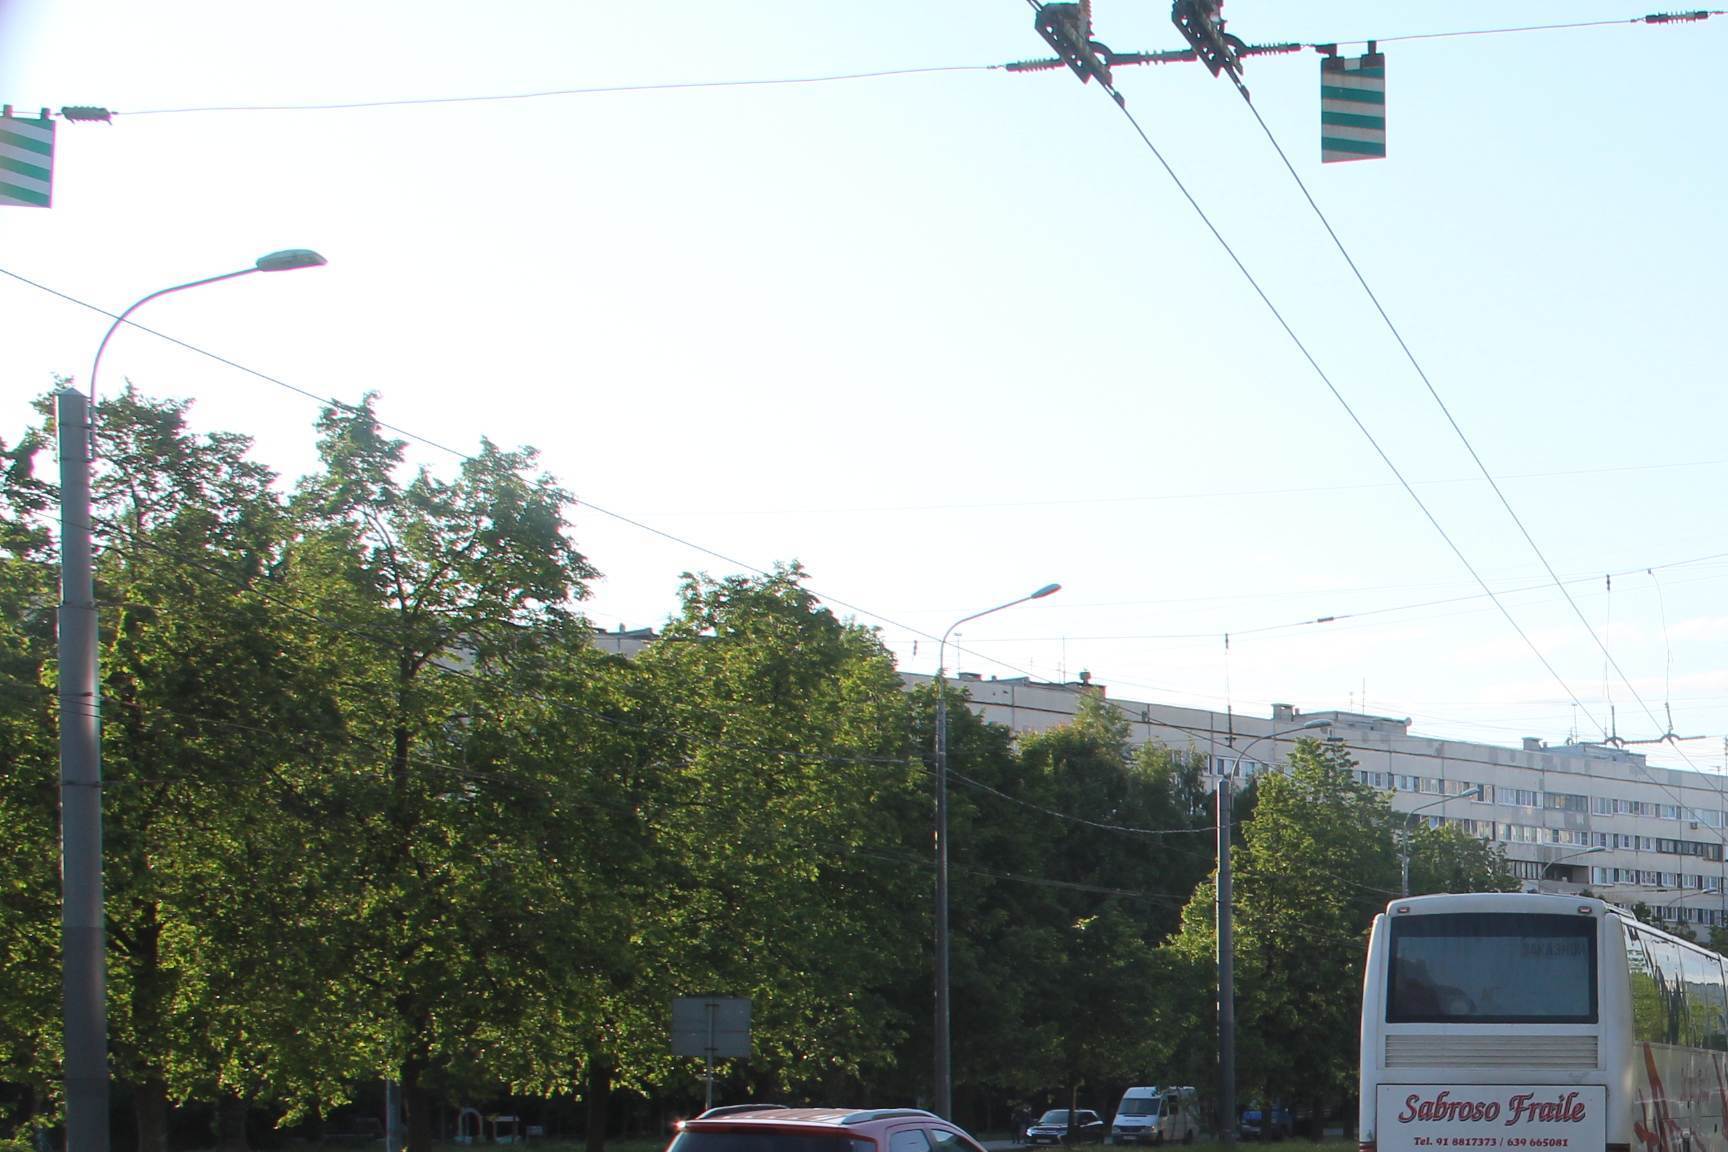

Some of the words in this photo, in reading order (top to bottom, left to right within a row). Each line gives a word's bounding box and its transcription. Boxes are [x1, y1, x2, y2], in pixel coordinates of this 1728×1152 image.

[1398, 1090, 1501, 1124] Sabroso
[1505, 1090, 1586, 1127] Fraile
[1413, 1136, 1433, 1146] Tel.
[1436, 1136, 1449, 1146] 91
[1451, 1137, 1497, 1147] 8817373
[1507, 1137, 1527, 1147] 639
[1529, 1137, 1569, 1148] 665081
